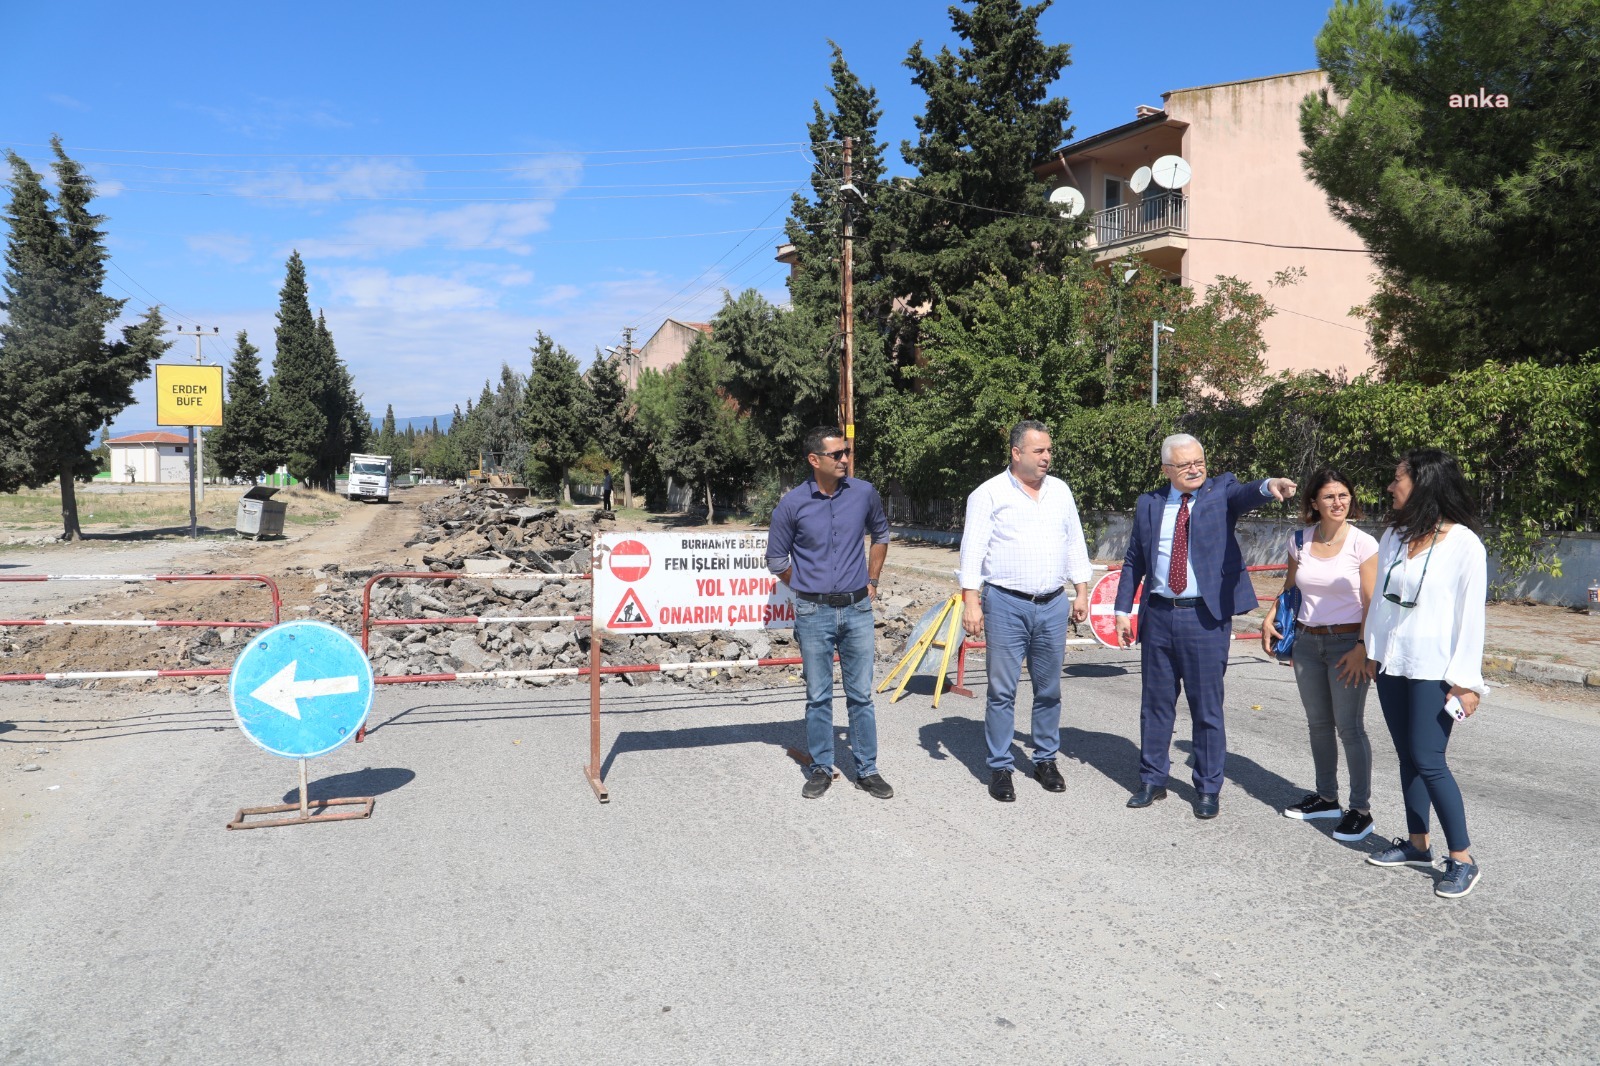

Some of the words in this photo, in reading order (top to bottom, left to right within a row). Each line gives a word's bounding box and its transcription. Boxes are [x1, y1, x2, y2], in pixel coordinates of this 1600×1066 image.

[172, 384, 207, 395] ERDEM
[176, 394, 203, 406] BÜFE
[664, 557, 688, 571] FEN
[691, 553, 730, 572] İŞLERİ
[695, 578, 725, 597] YOL
[729, 577, 777, 596] YAPIM
[659, 605, 723, 625] ONARIM
[727, 604, 796, 627] ÇALIŞMA
